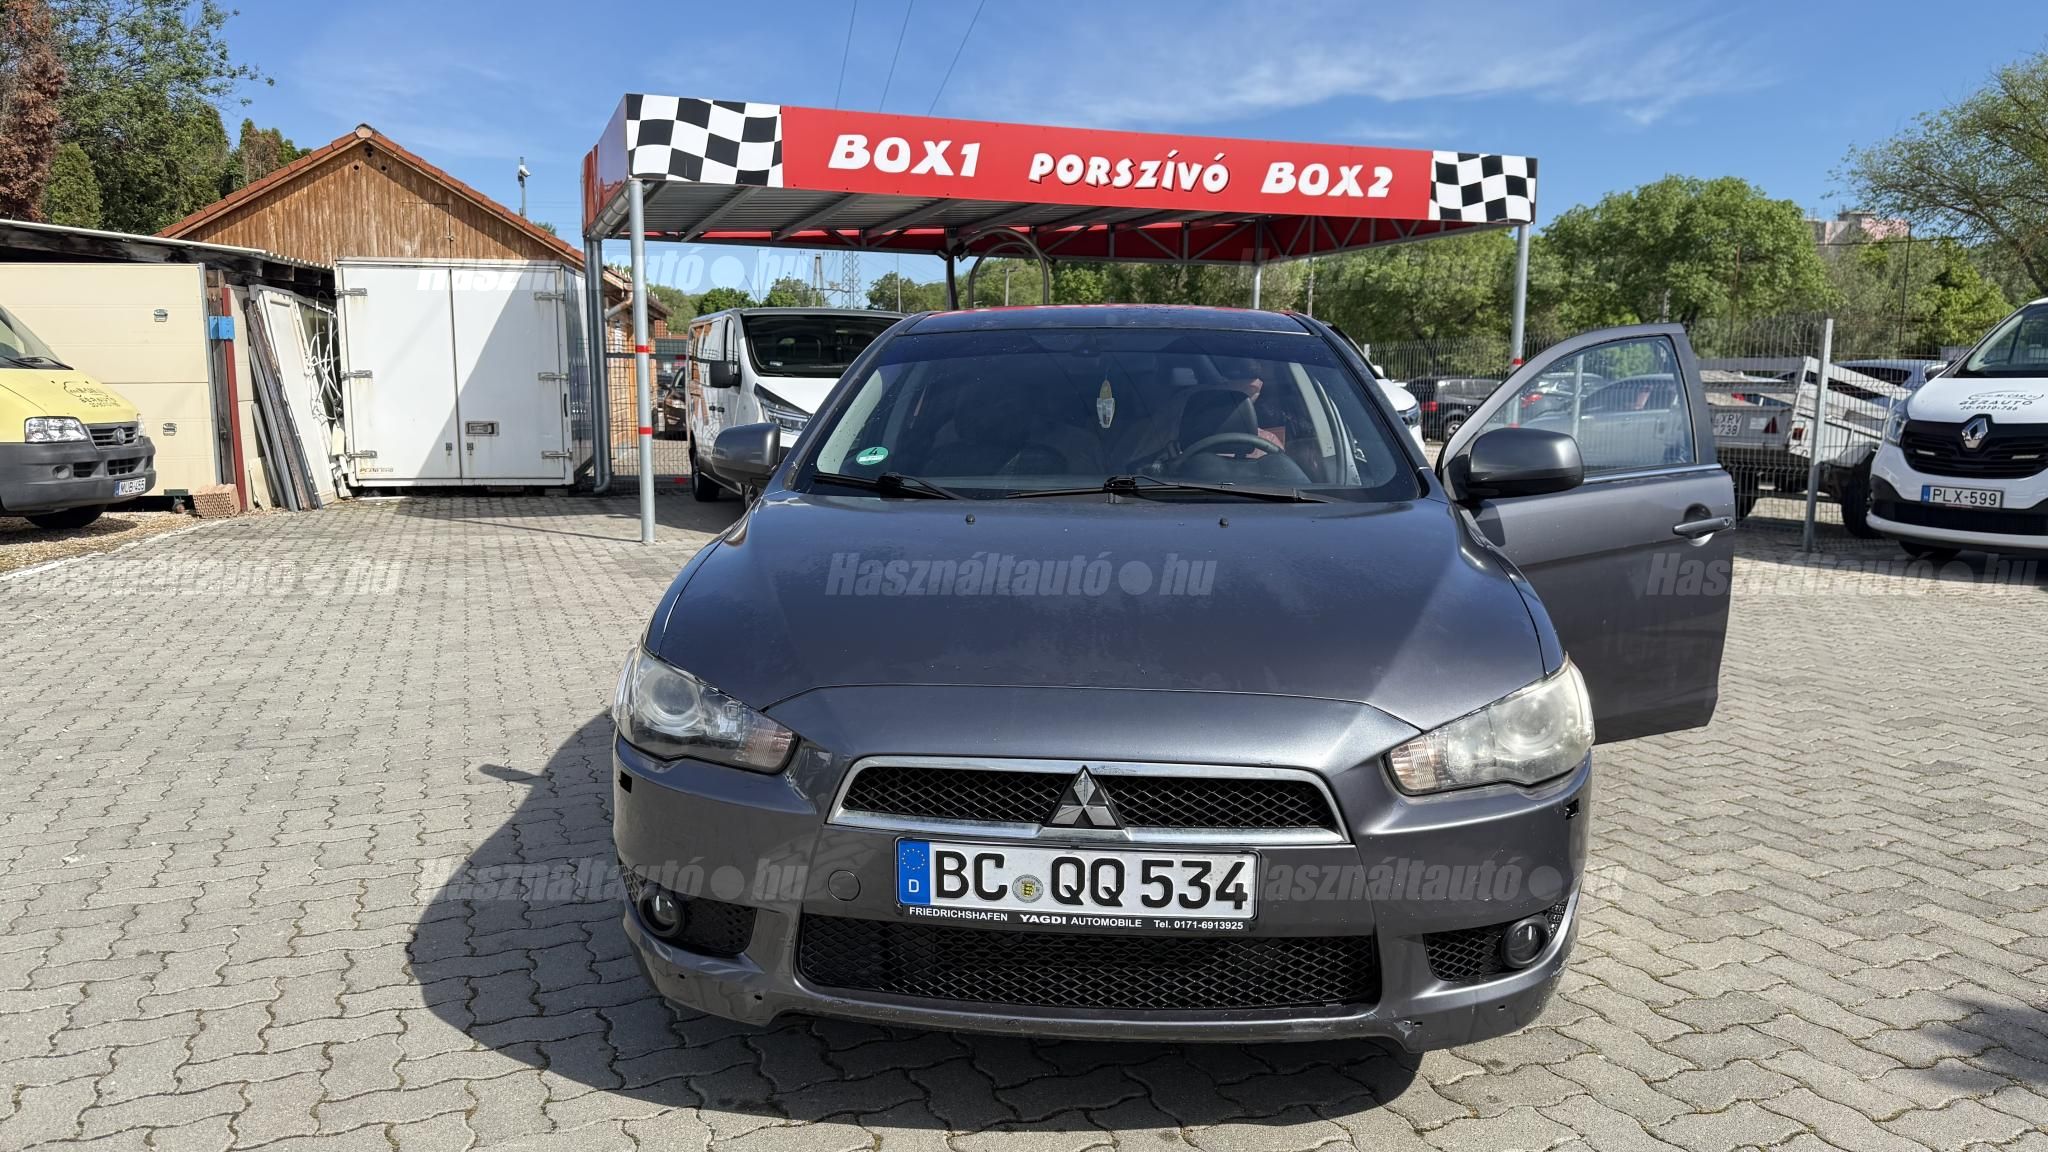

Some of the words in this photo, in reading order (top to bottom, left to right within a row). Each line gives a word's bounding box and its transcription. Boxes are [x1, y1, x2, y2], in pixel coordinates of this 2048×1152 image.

[828, 134, 981, 177] BOX1
[1028, 149, 1230, 193] PORSZÍVÓ
[1260, 161, 1394, 198] BOX2
[868, 447, 878, 455] 4
[1933, 488, 1997, 506] PLX-599
[908, 879, 920, 893] D
[935, 850, 1008, 901] BC
[1050, 856, 1126, 907] QQ
[1140, 859, 1248, 910] 534
[909, 906, 1008, 921] FRIEDRICHSHAFEN
[1019, 913, 1067, 925] YAGDI
[1071, 916, 1142, 928] AUTOMOBILE
[1153, 919, 1172, 929] Tel.
[1174, 919, 1244, 930] 0171-6913925
